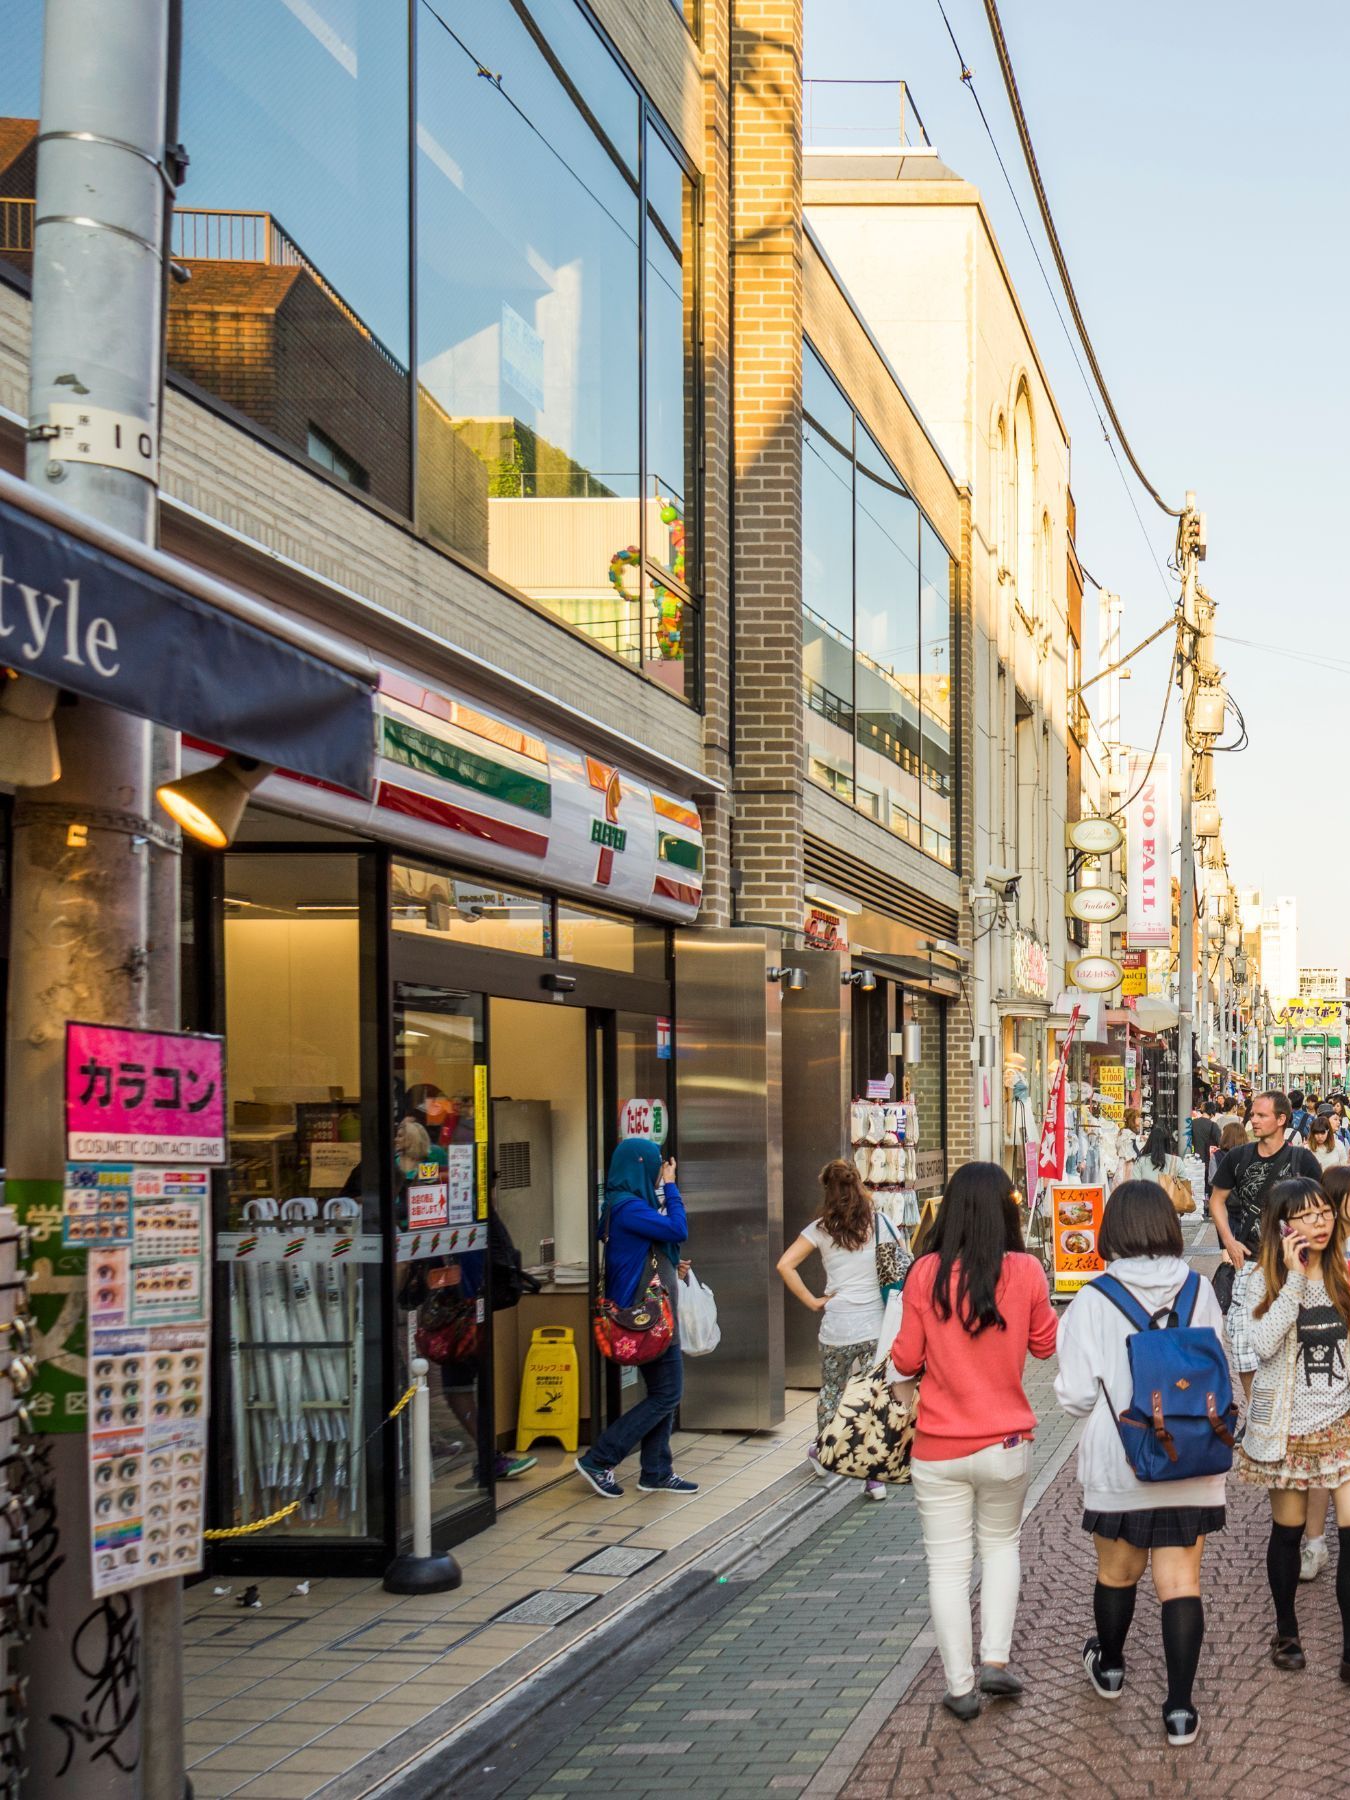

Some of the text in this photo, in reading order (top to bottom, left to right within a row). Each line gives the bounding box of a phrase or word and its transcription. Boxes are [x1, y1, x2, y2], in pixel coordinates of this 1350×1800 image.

[1142, 784, 1156, 913] NO FALL
[79, 1057, 215, 1113] カラコン
[627, 1106, 649, 1134] たばこ
[1059, 1190, 1100, 1201] とんかつ
